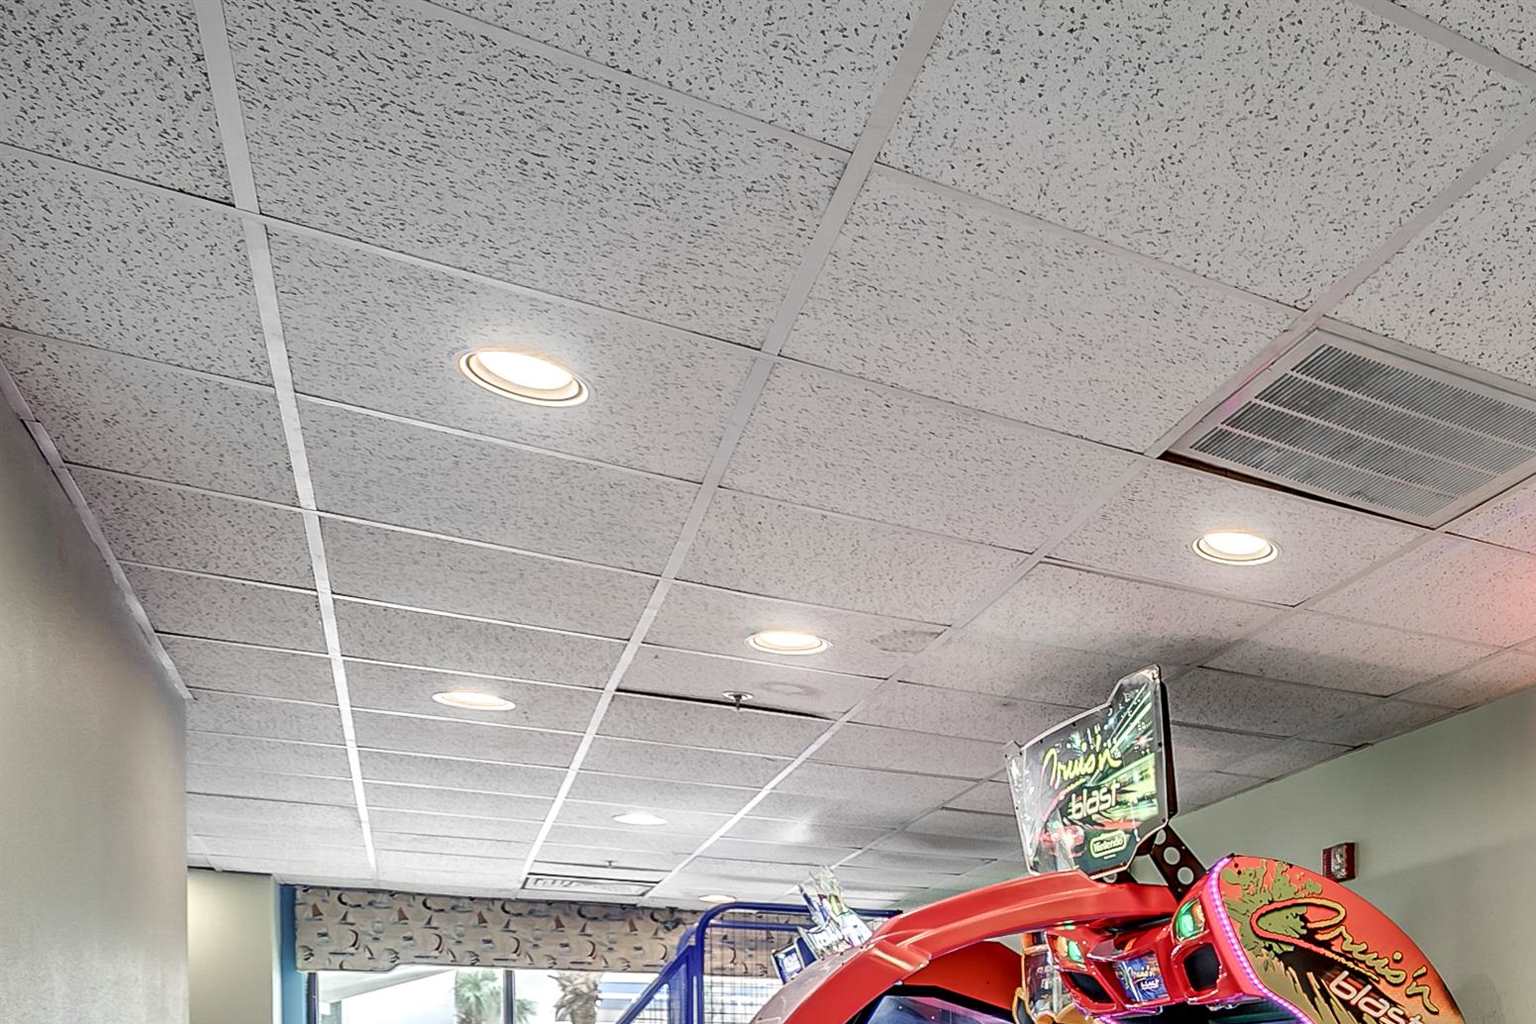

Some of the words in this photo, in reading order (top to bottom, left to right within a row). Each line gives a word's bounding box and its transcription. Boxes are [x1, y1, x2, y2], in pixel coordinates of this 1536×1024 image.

[1070, 781, 1120, 820] blast
[1093, 838, 1124, 853] Nintendo
[1250, 896, 1440, 1015] Cruis'n
